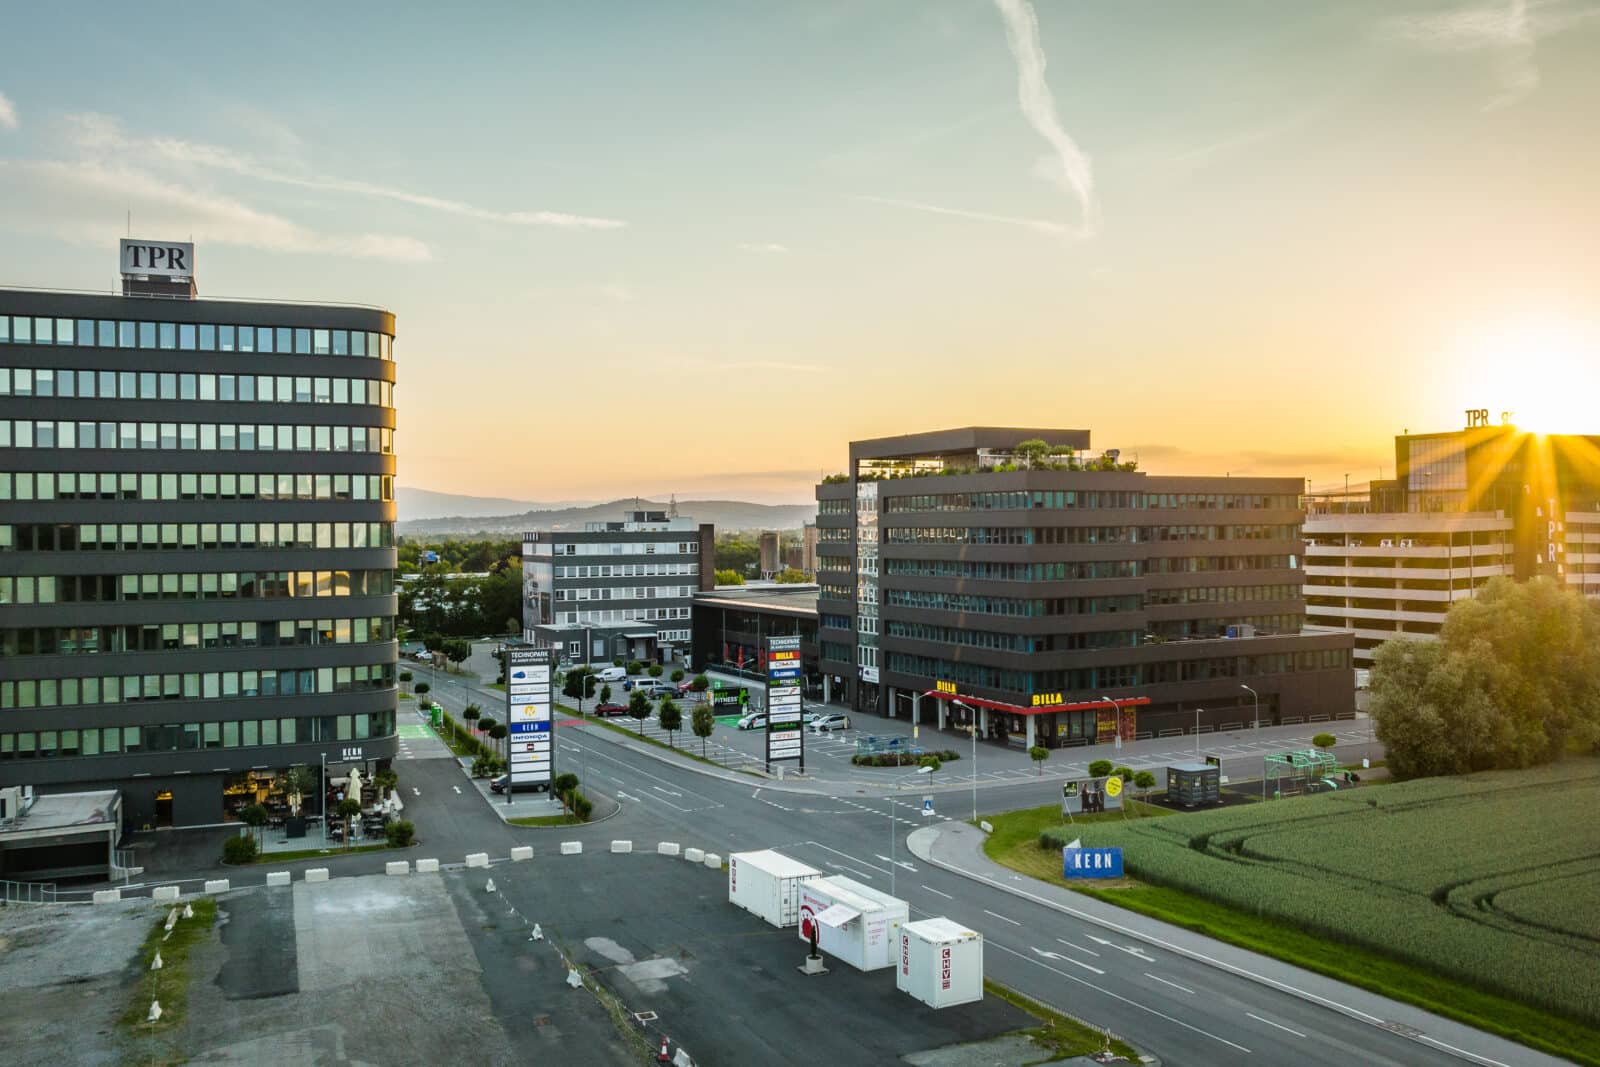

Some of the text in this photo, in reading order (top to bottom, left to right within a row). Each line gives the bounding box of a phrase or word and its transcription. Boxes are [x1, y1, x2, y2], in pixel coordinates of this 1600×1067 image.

[127, 245, 186, 270] TPR
[1465, 409, 1488, 426] TPR
[937, 681, 957, 695] BILLA
[1032, 693, 1062, 706] BILLA
[1075, 853, 1112, 869] KERN
